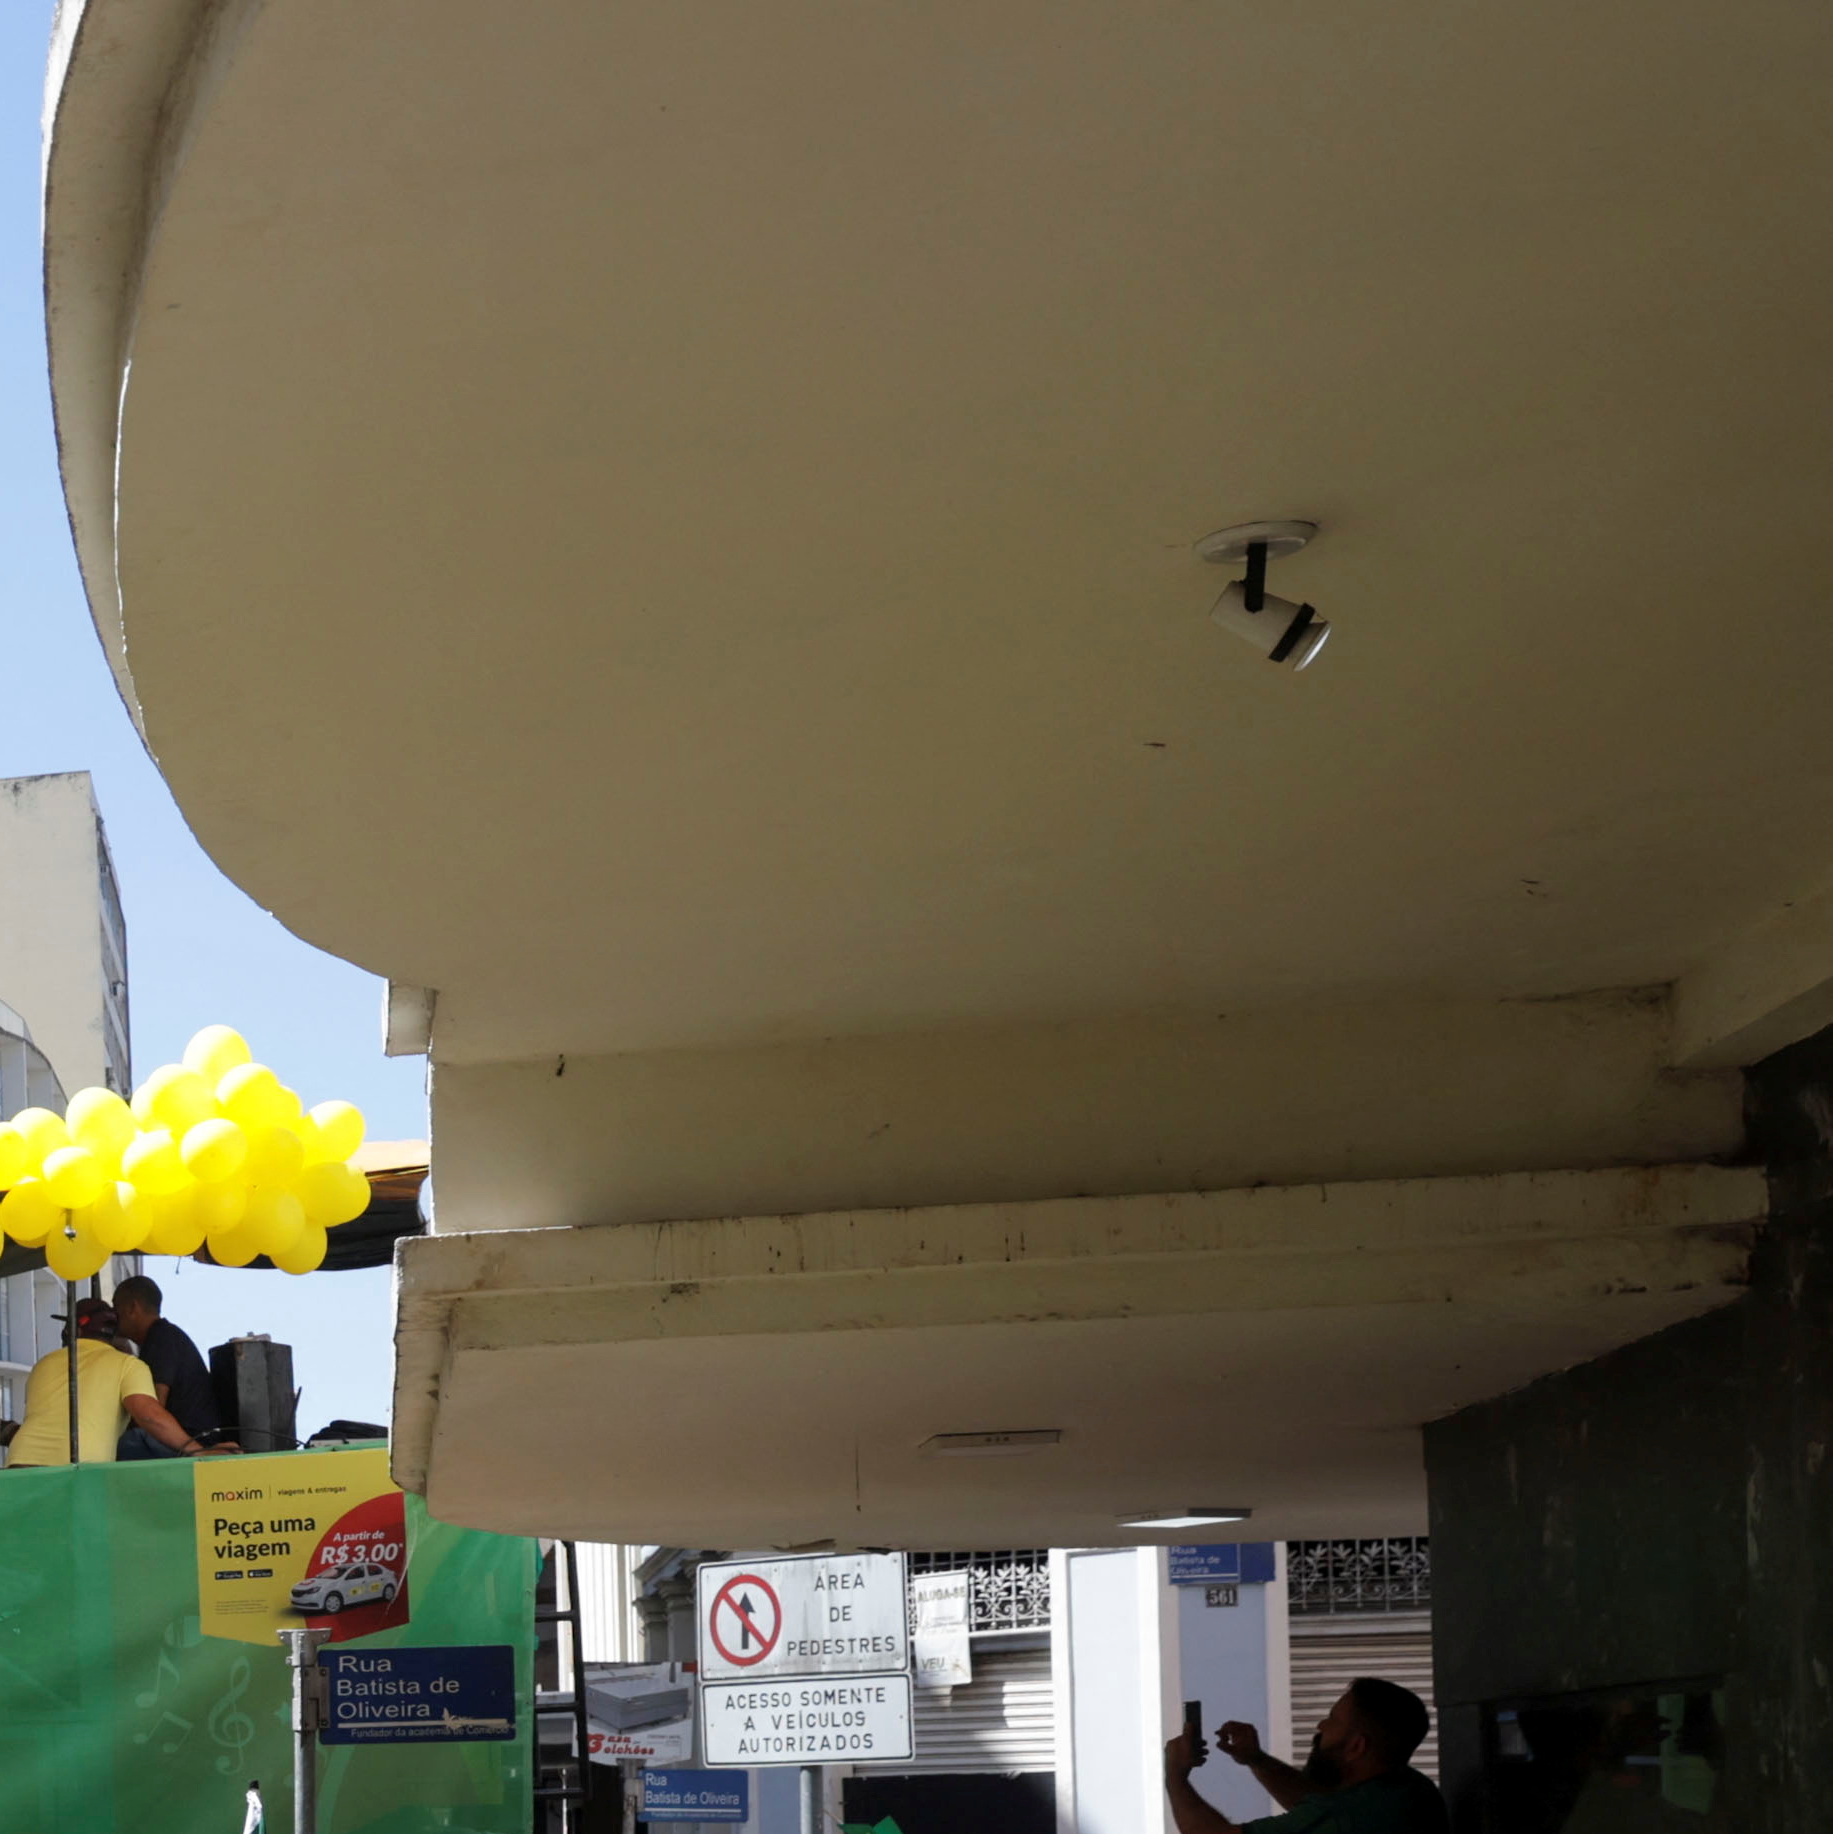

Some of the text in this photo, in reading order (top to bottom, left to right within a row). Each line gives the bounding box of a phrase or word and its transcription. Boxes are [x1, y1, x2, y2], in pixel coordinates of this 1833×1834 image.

[211, 1487, 263, 1502] maxim
[214, 1517, 316, 1538] Peça uma
[333, 1530, 385, 1543] A partir de
[214, 1540, 290, 1560] viagem
[321, 1546, 350, 1564] R$
[829, 1605, 852, 1622] DE
[787, 1636, 896, 1656] PEDESTRES
[338, 1655, 393, 1673] Rua
[337, 1677, 460, 1697] Batista de
[725, 1687, 886, 1710] ACESSO SOMENTE
[337, 1702, 431, 1719] Oliveira
[744, 1710, 866, 1731] A VEÍCULOS
[738, 1733, 874, 1754] AUTORIZADOS
[645, 1772, 667, 1786] Rua
[645, 1791, 740, 1805] Batista de Oliveira
